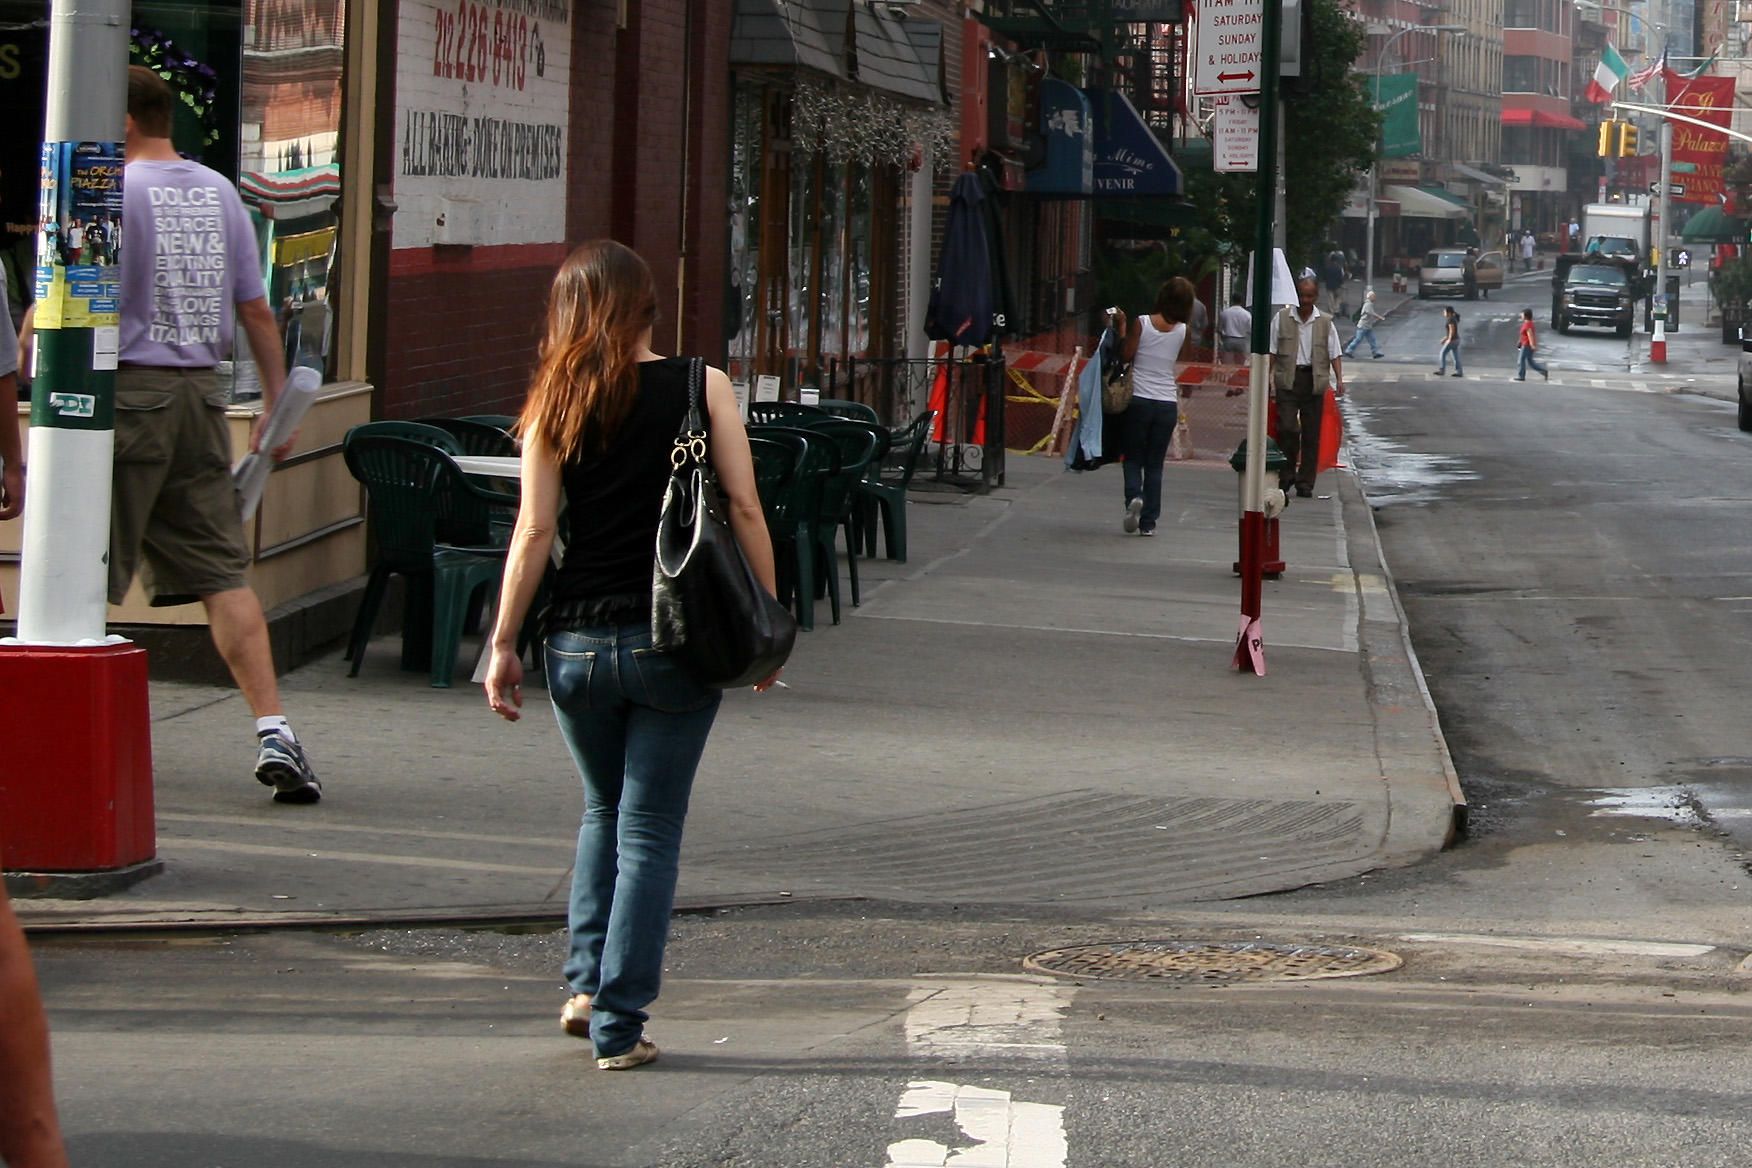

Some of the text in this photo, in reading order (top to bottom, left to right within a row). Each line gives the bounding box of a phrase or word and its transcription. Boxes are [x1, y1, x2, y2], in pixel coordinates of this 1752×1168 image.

[1213, 14, 1263, 27] SATURDAY
[1217, 33, 1256, 47] SUNDAY
[1208, 54, 1215, 65] &
[403, 109, 425, 176] ALL
[148, 187, 221, 206] DOLCE
[156, 232, 225, 254] NEW &
[154, 270, 225, 287] QUALITY
